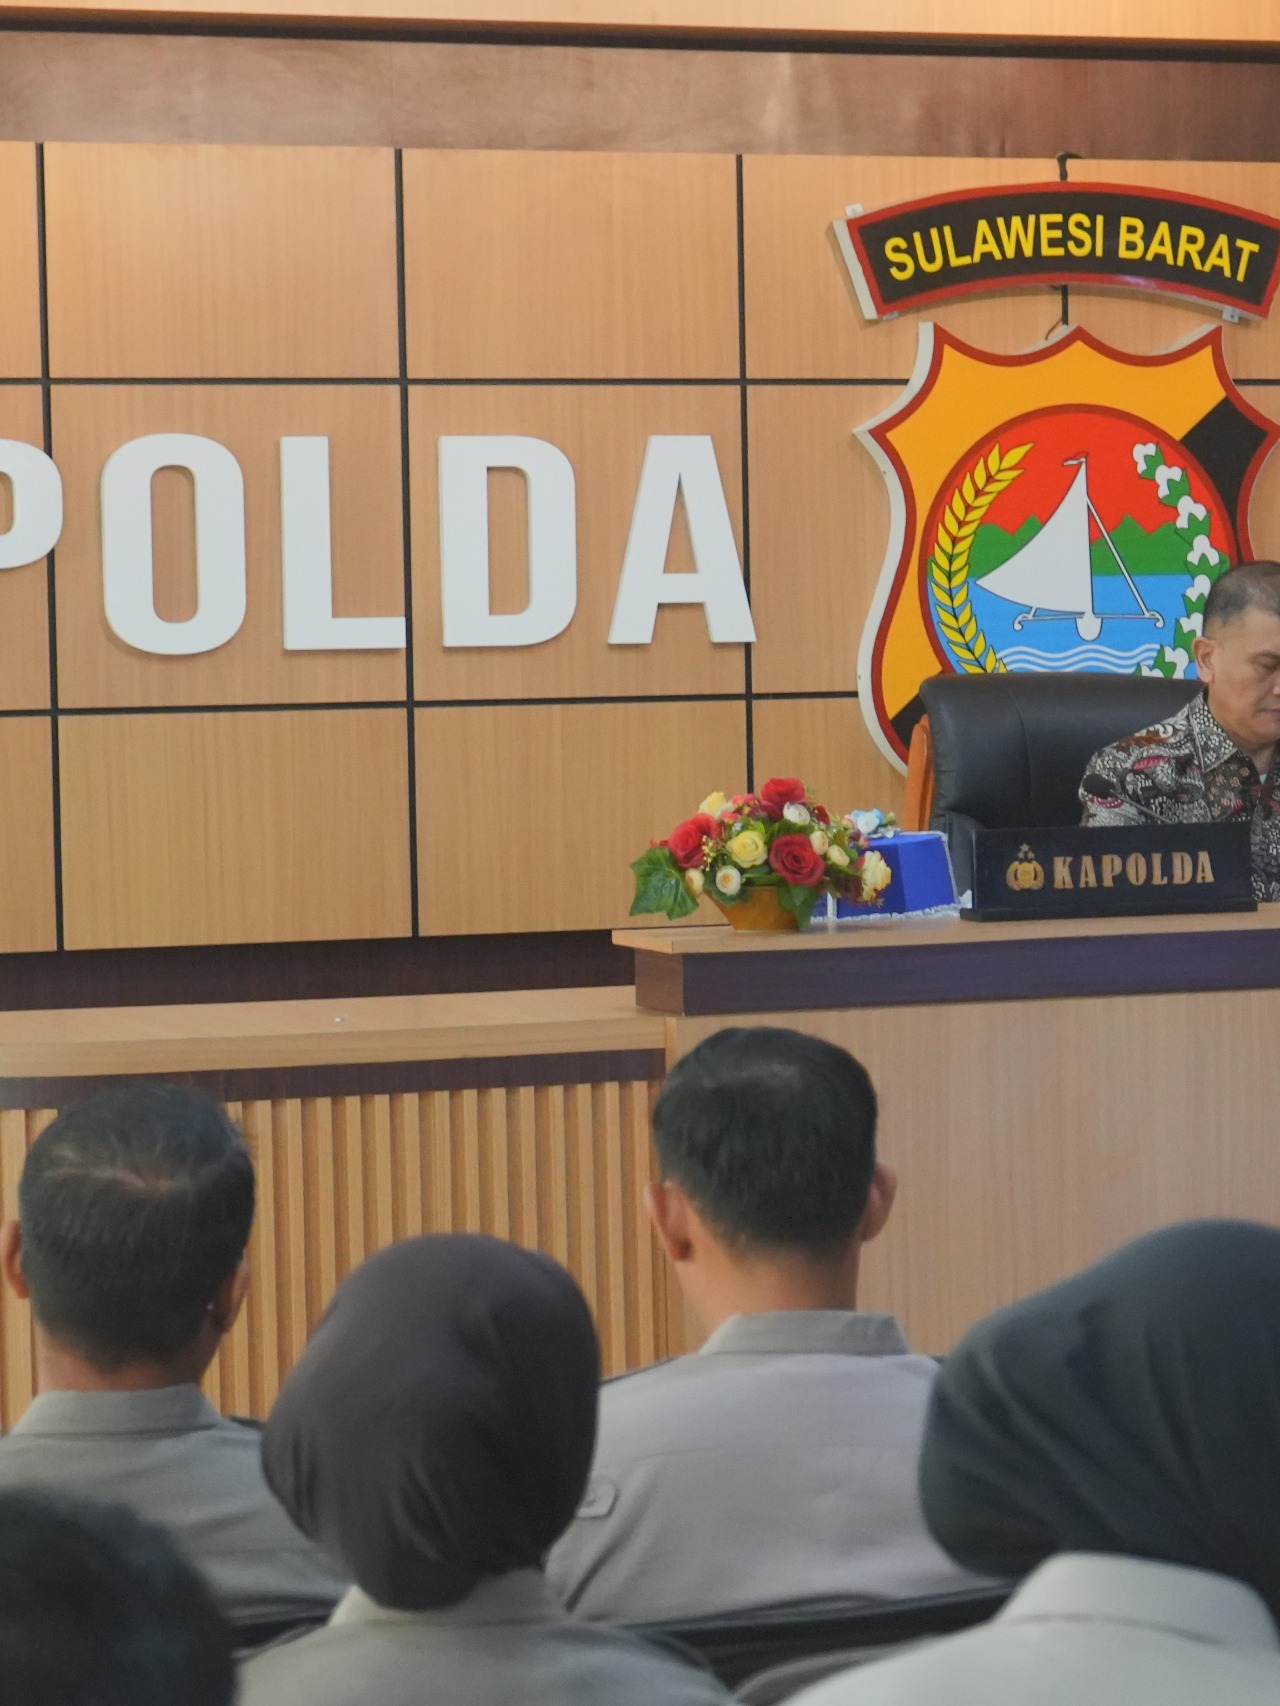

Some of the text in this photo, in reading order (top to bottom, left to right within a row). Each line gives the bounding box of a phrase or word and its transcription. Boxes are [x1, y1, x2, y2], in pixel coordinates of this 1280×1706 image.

[884, 213, 1261, 283] SULAWESI BARAT
[1053, 851, 1215, 889] KAPOLDA
